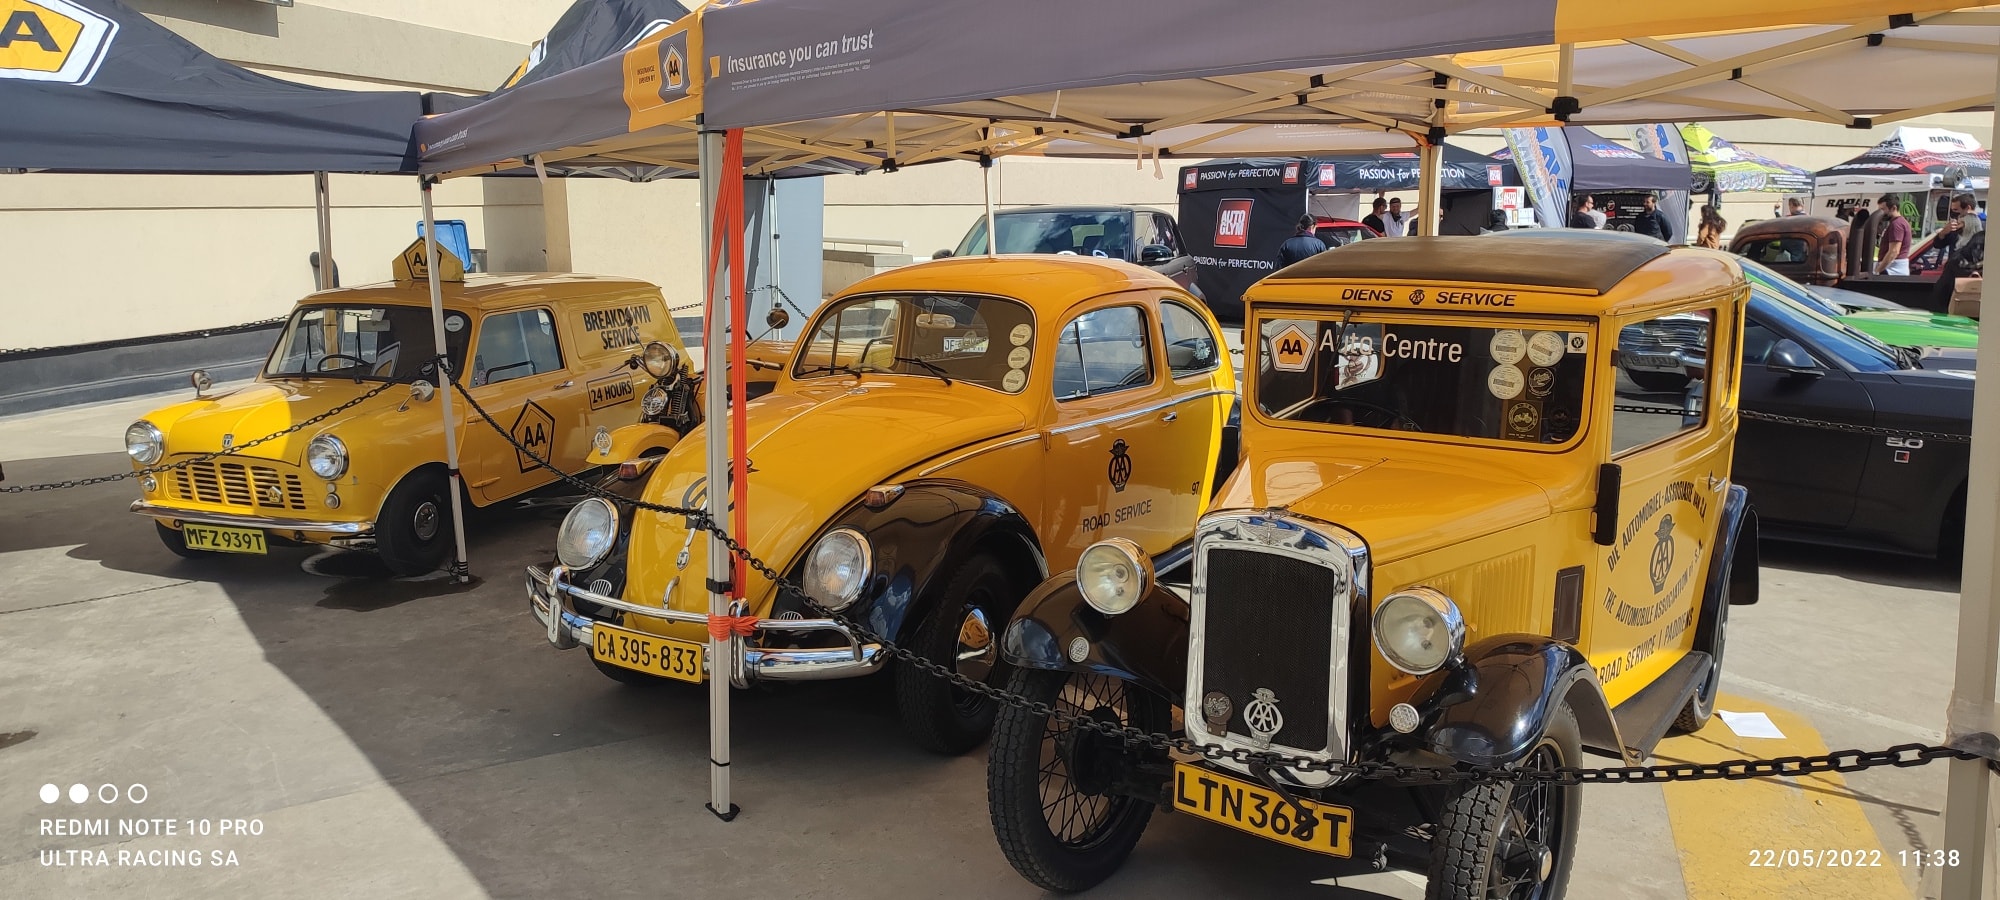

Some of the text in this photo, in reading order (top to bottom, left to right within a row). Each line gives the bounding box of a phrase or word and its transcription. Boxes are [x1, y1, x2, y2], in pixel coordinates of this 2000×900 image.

[727, 28, 874, 74] Insurance you can trust
[669, 59, 680, 78] AA
[1200, 168, 1280, 181] PASSION for PERFECTION
[1359, 168, 1395, 180] PASSION
[1396, 168, 1410, 182] for
[1221, 210, 1246, 222] AUTO
[1219, 221, 1245, 236] GLYM
[1193, 255, 1274, 270] PASSION for PERFECTION
[1341, 288, 1393, 302] DIENS
[1436, 291, 1517, 307] SERVICE
[601, 326, 640, 350] SERVICE
[1280, 339, 1303, 356] AA
[1382, 332, 1463, 363] Centre
[591, 380, 632, 404] 24 HOURS
[524, 422, 547, 449] AA
[1191, 481, 1200, 496] 97
[1082, 499, 1152, 534] ROAD SERVICE
[185, 527, 262, 551] MFZ939T
[1607, 544, 1621, 573] DIE
[1602, 587, 1617, 615] THE
[1615, 600, 1655, 627] AUTOMOBILE
[1653, 568, 1688, 622] ASSOCIATION
[598, 631, 697, 677] CA 395-833
[1600, 656, 1622, 686] ROAD
[1625, 633, 1657, 672] SERVICE
[1663, 606, 1694, 647] PADDIENS
